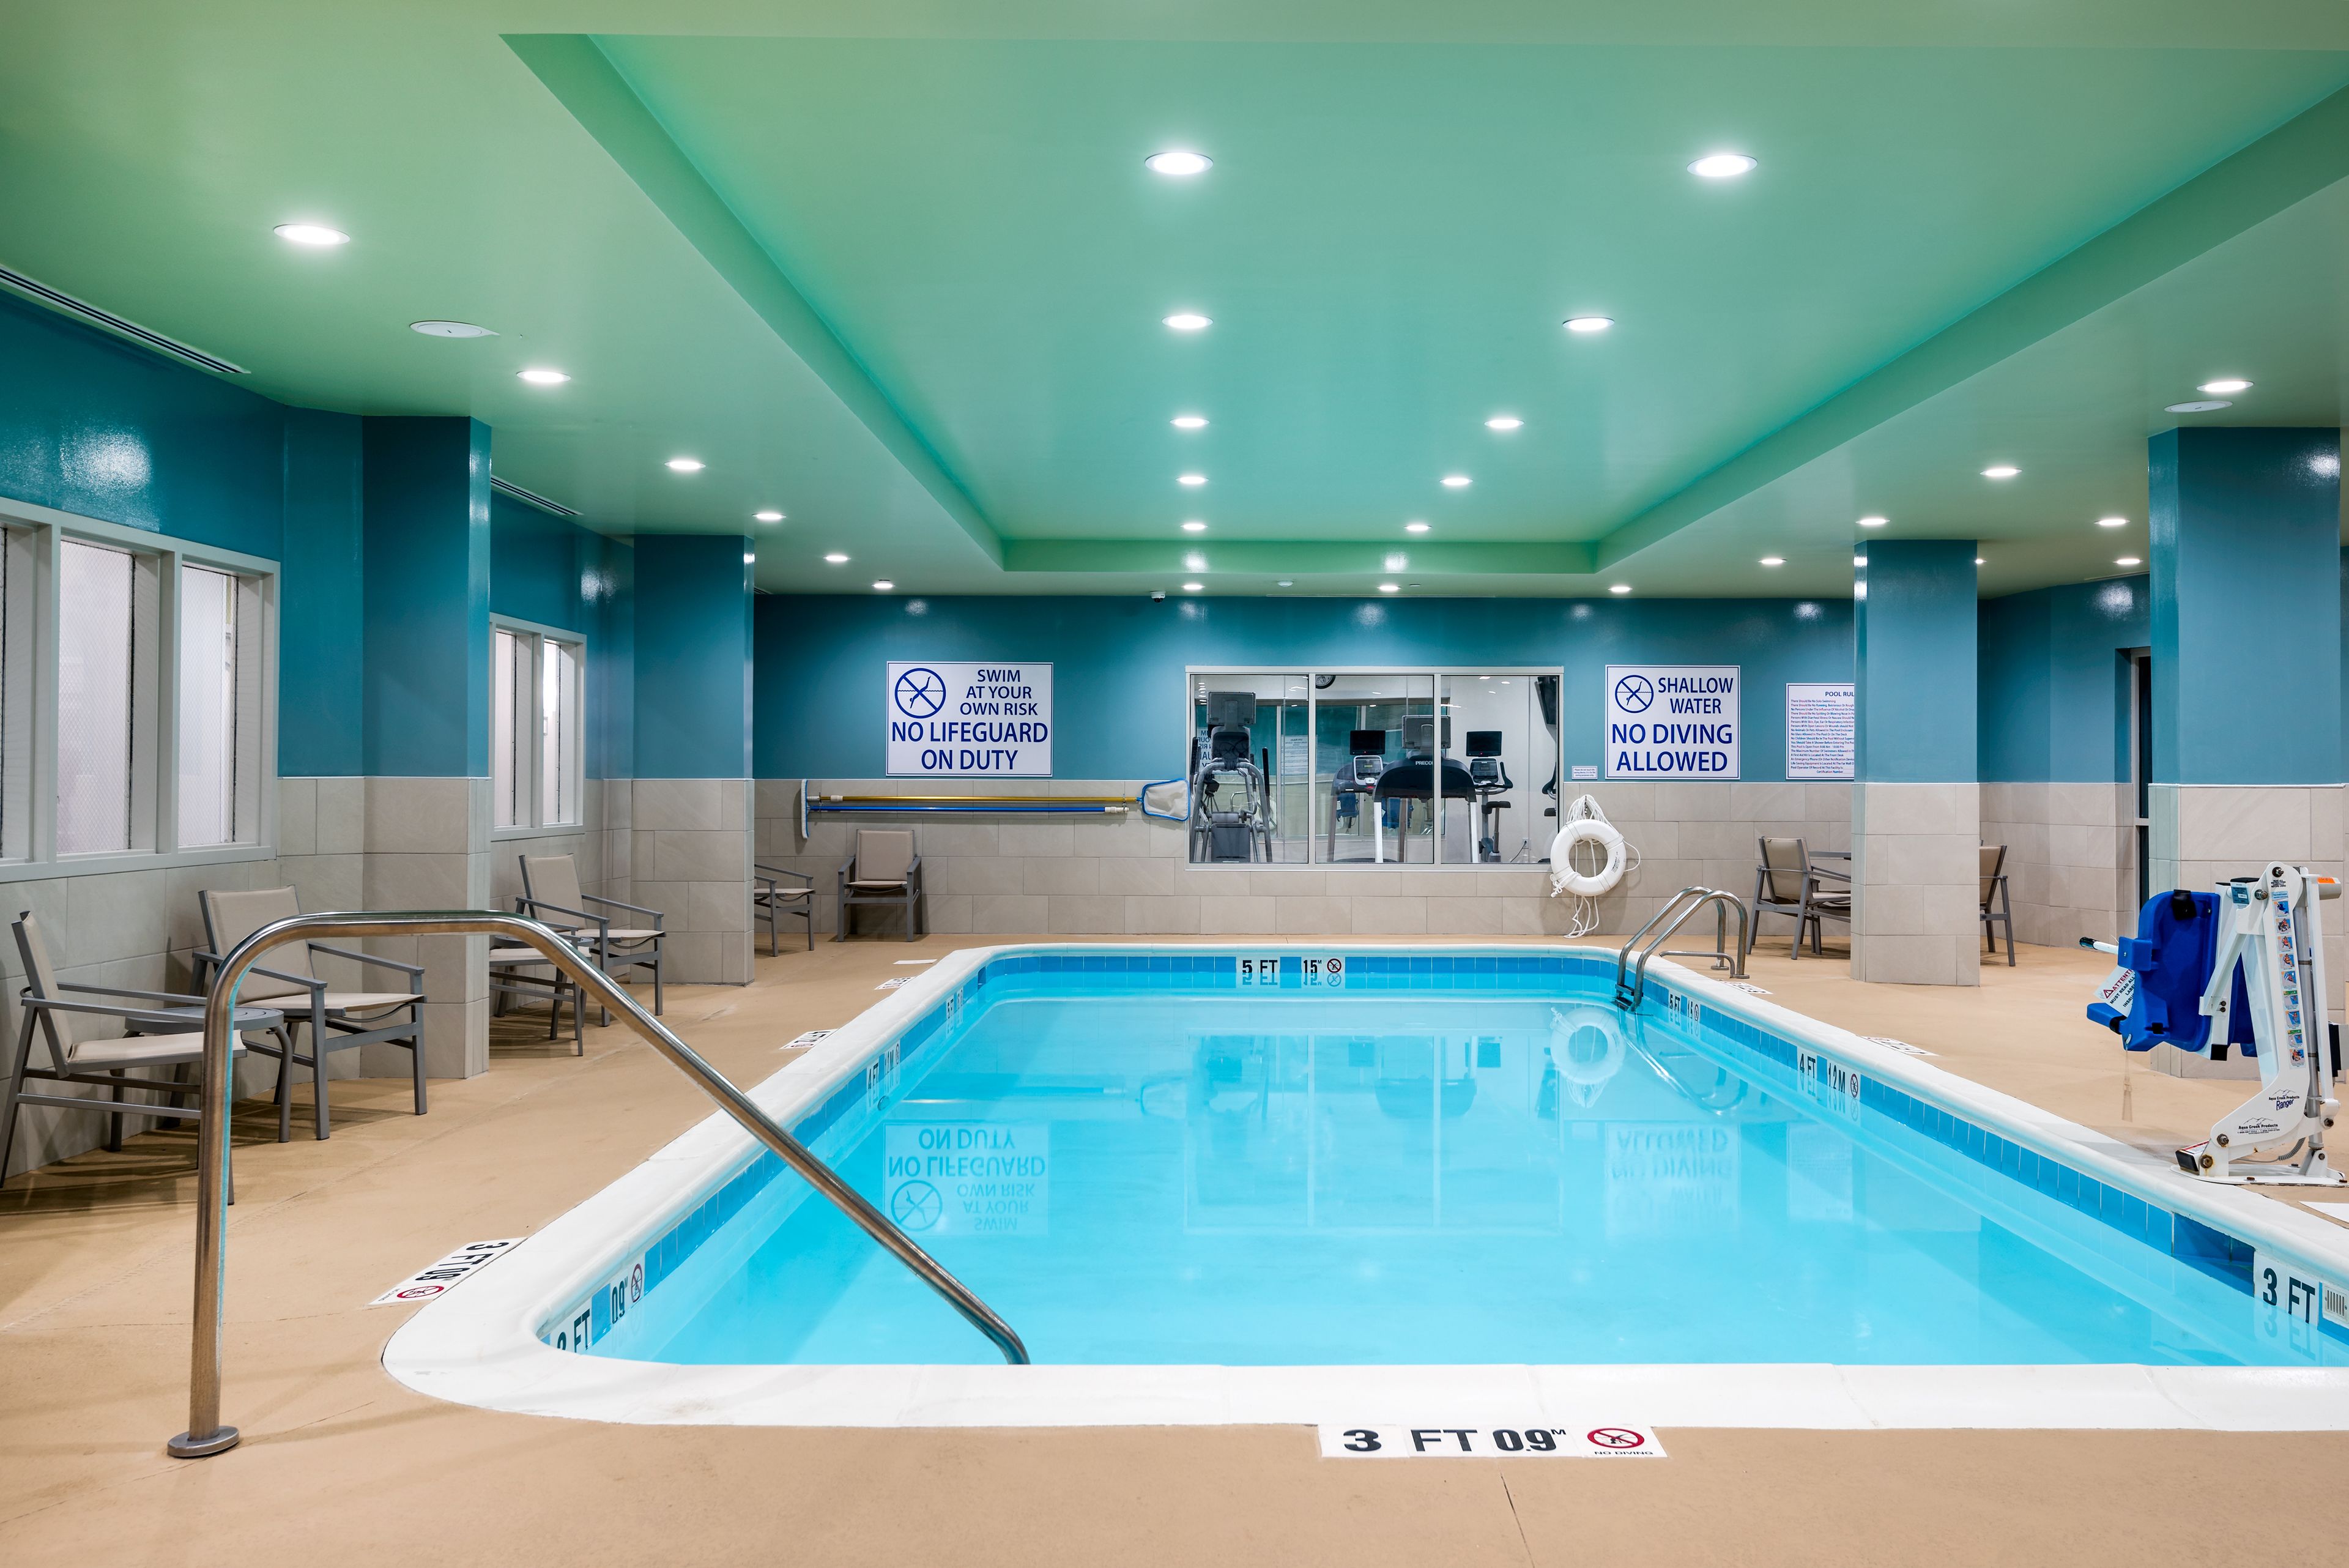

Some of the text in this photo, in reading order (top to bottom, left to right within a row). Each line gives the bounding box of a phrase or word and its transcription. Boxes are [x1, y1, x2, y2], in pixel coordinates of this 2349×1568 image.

[977, 669, 1020, 682] SWIM
[1658, 677, 1733, 693] SHALLOW
[966, 686, 1032, 699] AT YOUR
[960, 702, 1038, 716] OWN RISK
[1669, 698, 1721, 714] WATER
[892, 721, 1048, 743] NO LIFEGUARD
[1612, 724, 1732, 744] NO DIVING
[921, 749, 1019, 770] ON DUTY
[1616, 751, 1727, 771] ALLOWED
[1242, 959, 1253, 973] 5
[1260, 959, 1278, 973] FT
[1669, 994, 1673, 1009] 5
[1674, 996, 1680, 1013] FT
[2110, 993, 2120, 1005] MUST
[2119, 983, 2129, 994] READ
[1800, 1053, 1805, 1073] 4
[1808, 1056, 1816, 1079] FT
[2276, 1099, 2294, 1111] Ranger
[466, 1242, 510, 1250] 3
[438, 1253, 494, 1266] FT
[2263, 1268, 2315, 1324] 3 FT
[574, 1308, 590, 1353] FT
[1343, 1429, 1382, 1452] 3
[1410, 1429, 1478, 1452] FT
